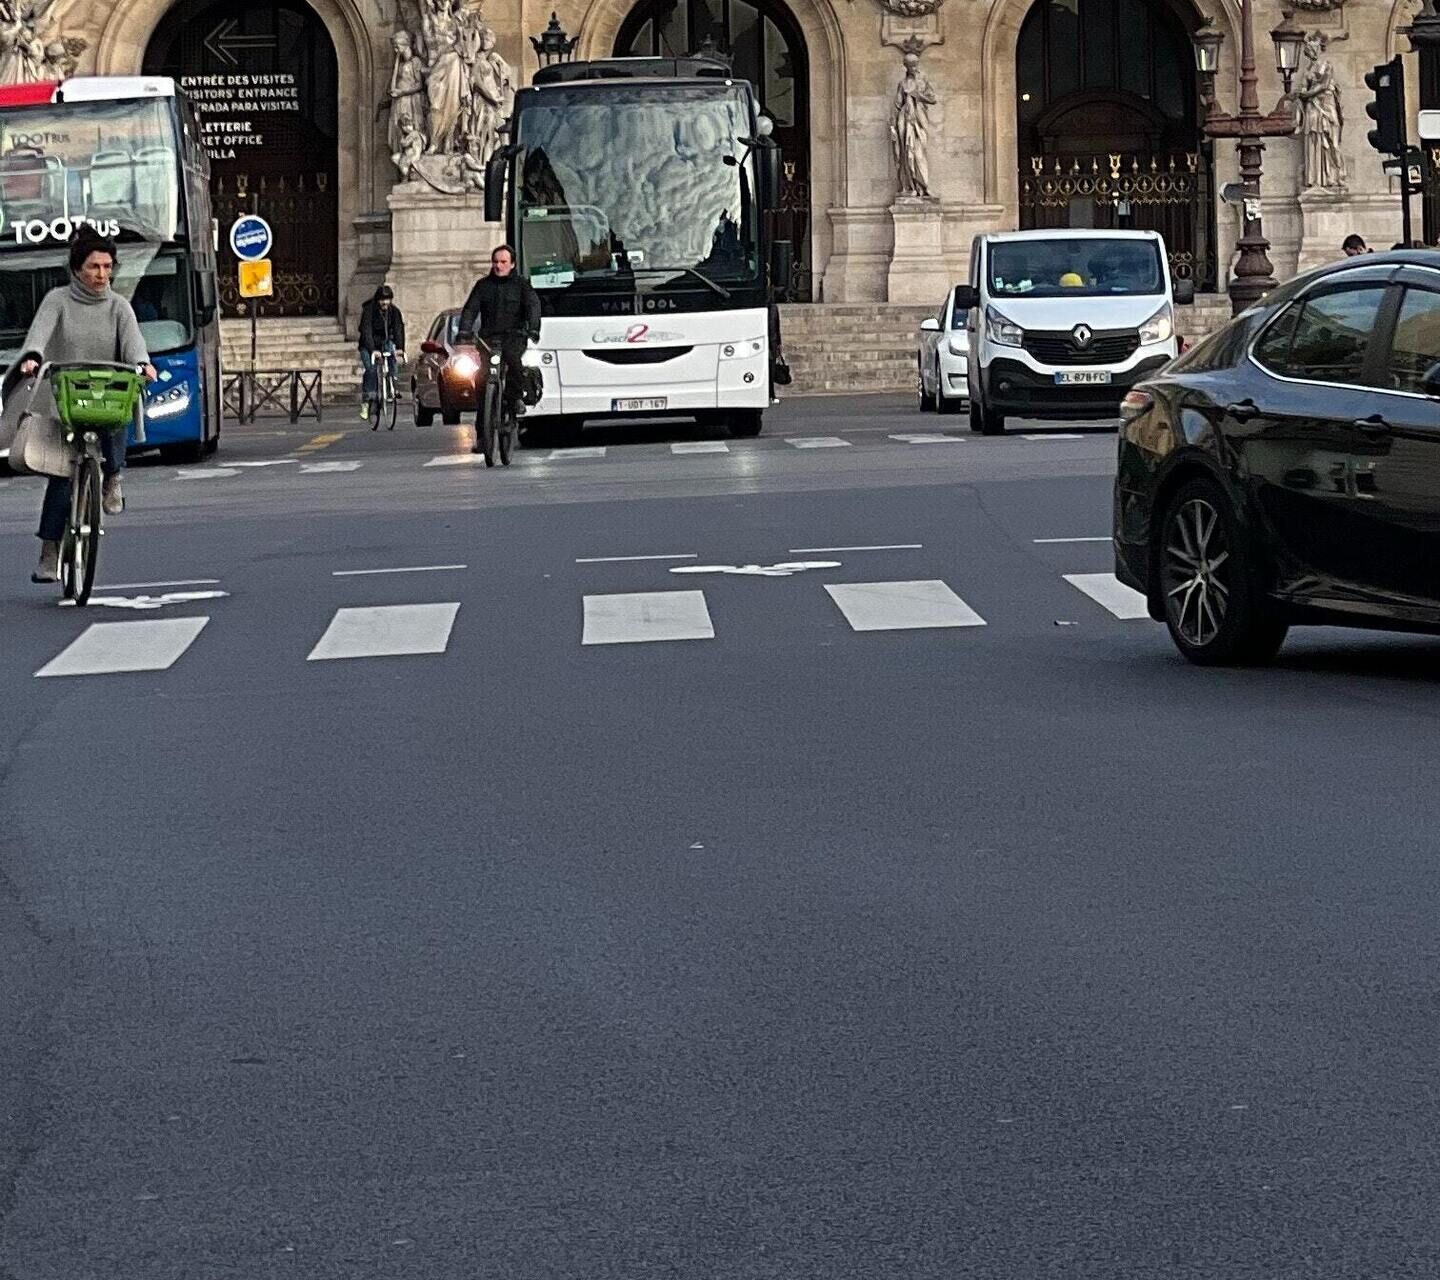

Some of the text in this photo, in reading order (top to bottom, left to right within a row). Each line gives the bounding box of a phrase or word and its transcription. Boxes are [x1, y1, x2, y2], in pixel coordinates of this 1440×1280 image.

[181, 74, 294, 86] ENTRÉE DES VISITES
[238, 87, 298, 98] ENTRANCE
[231, 102, 259, 112] PARA
[260, 101, 299, 111] VISITAS
[223, 135, 263, 145] OFFICE
